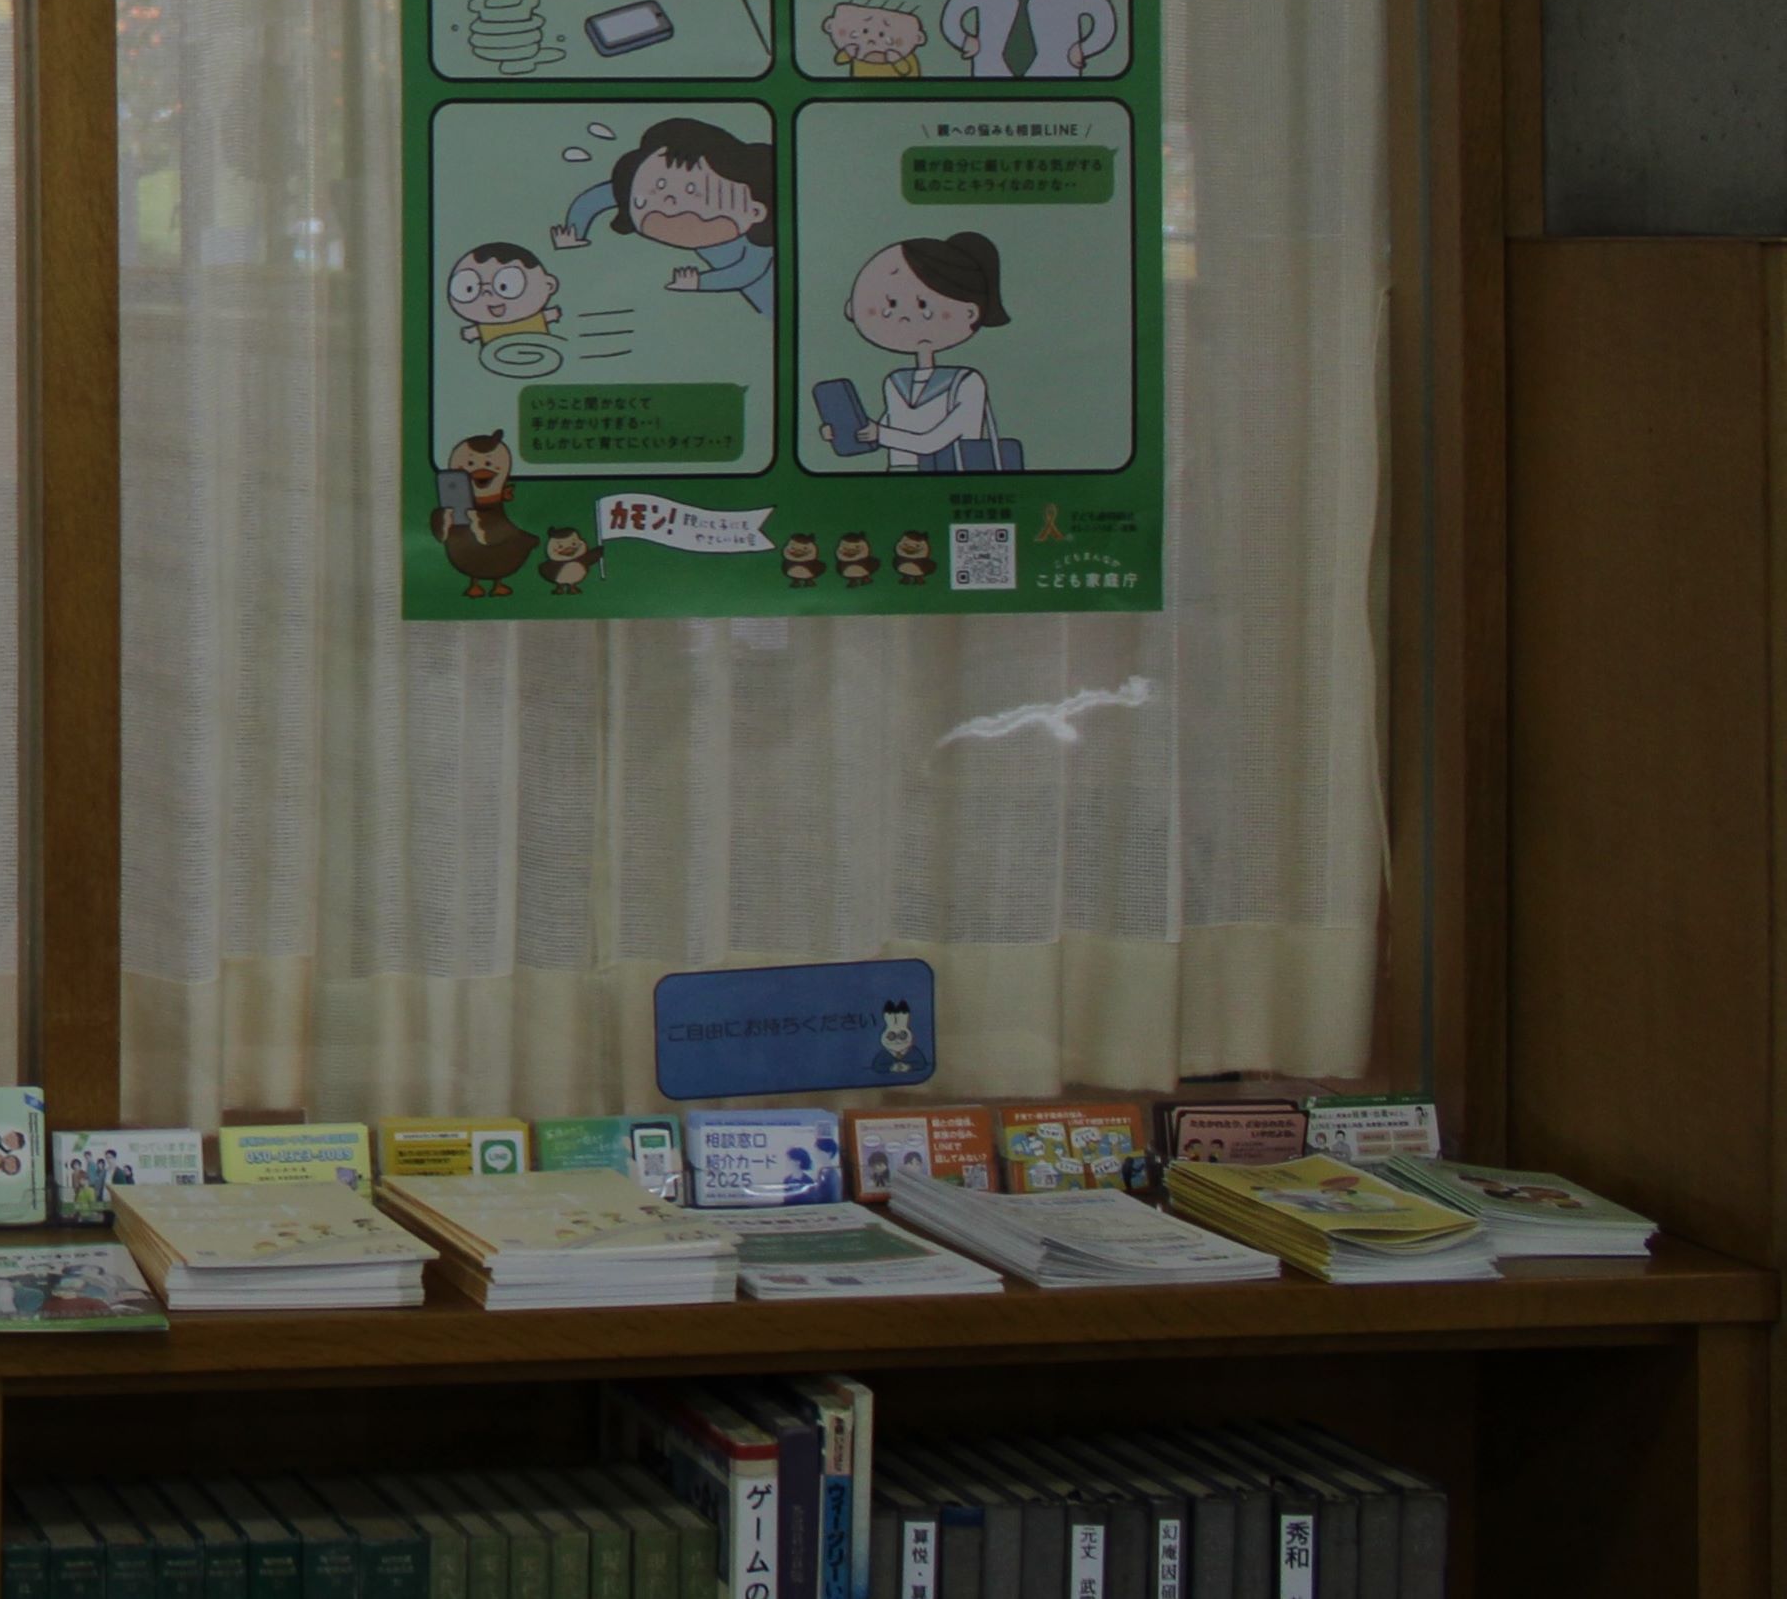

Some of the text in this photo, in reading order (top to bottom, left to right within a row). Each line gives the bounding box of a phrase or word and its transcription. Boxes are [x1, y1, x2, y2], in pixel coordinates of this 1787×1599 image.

[609, 500, 677, 535] カモン!
[1036, 572, 1139, 589] こども家庭庁
[667, 1012, 877, 1043] ご自由にお持ちください
[704, 1132, 767, 1149] 相談窓口
[704, 1153, 777, 1171] 紹介カード
[704, 1171, 753, 1189] 2025
[1285, 1521, 1310, 1570] 秀和
